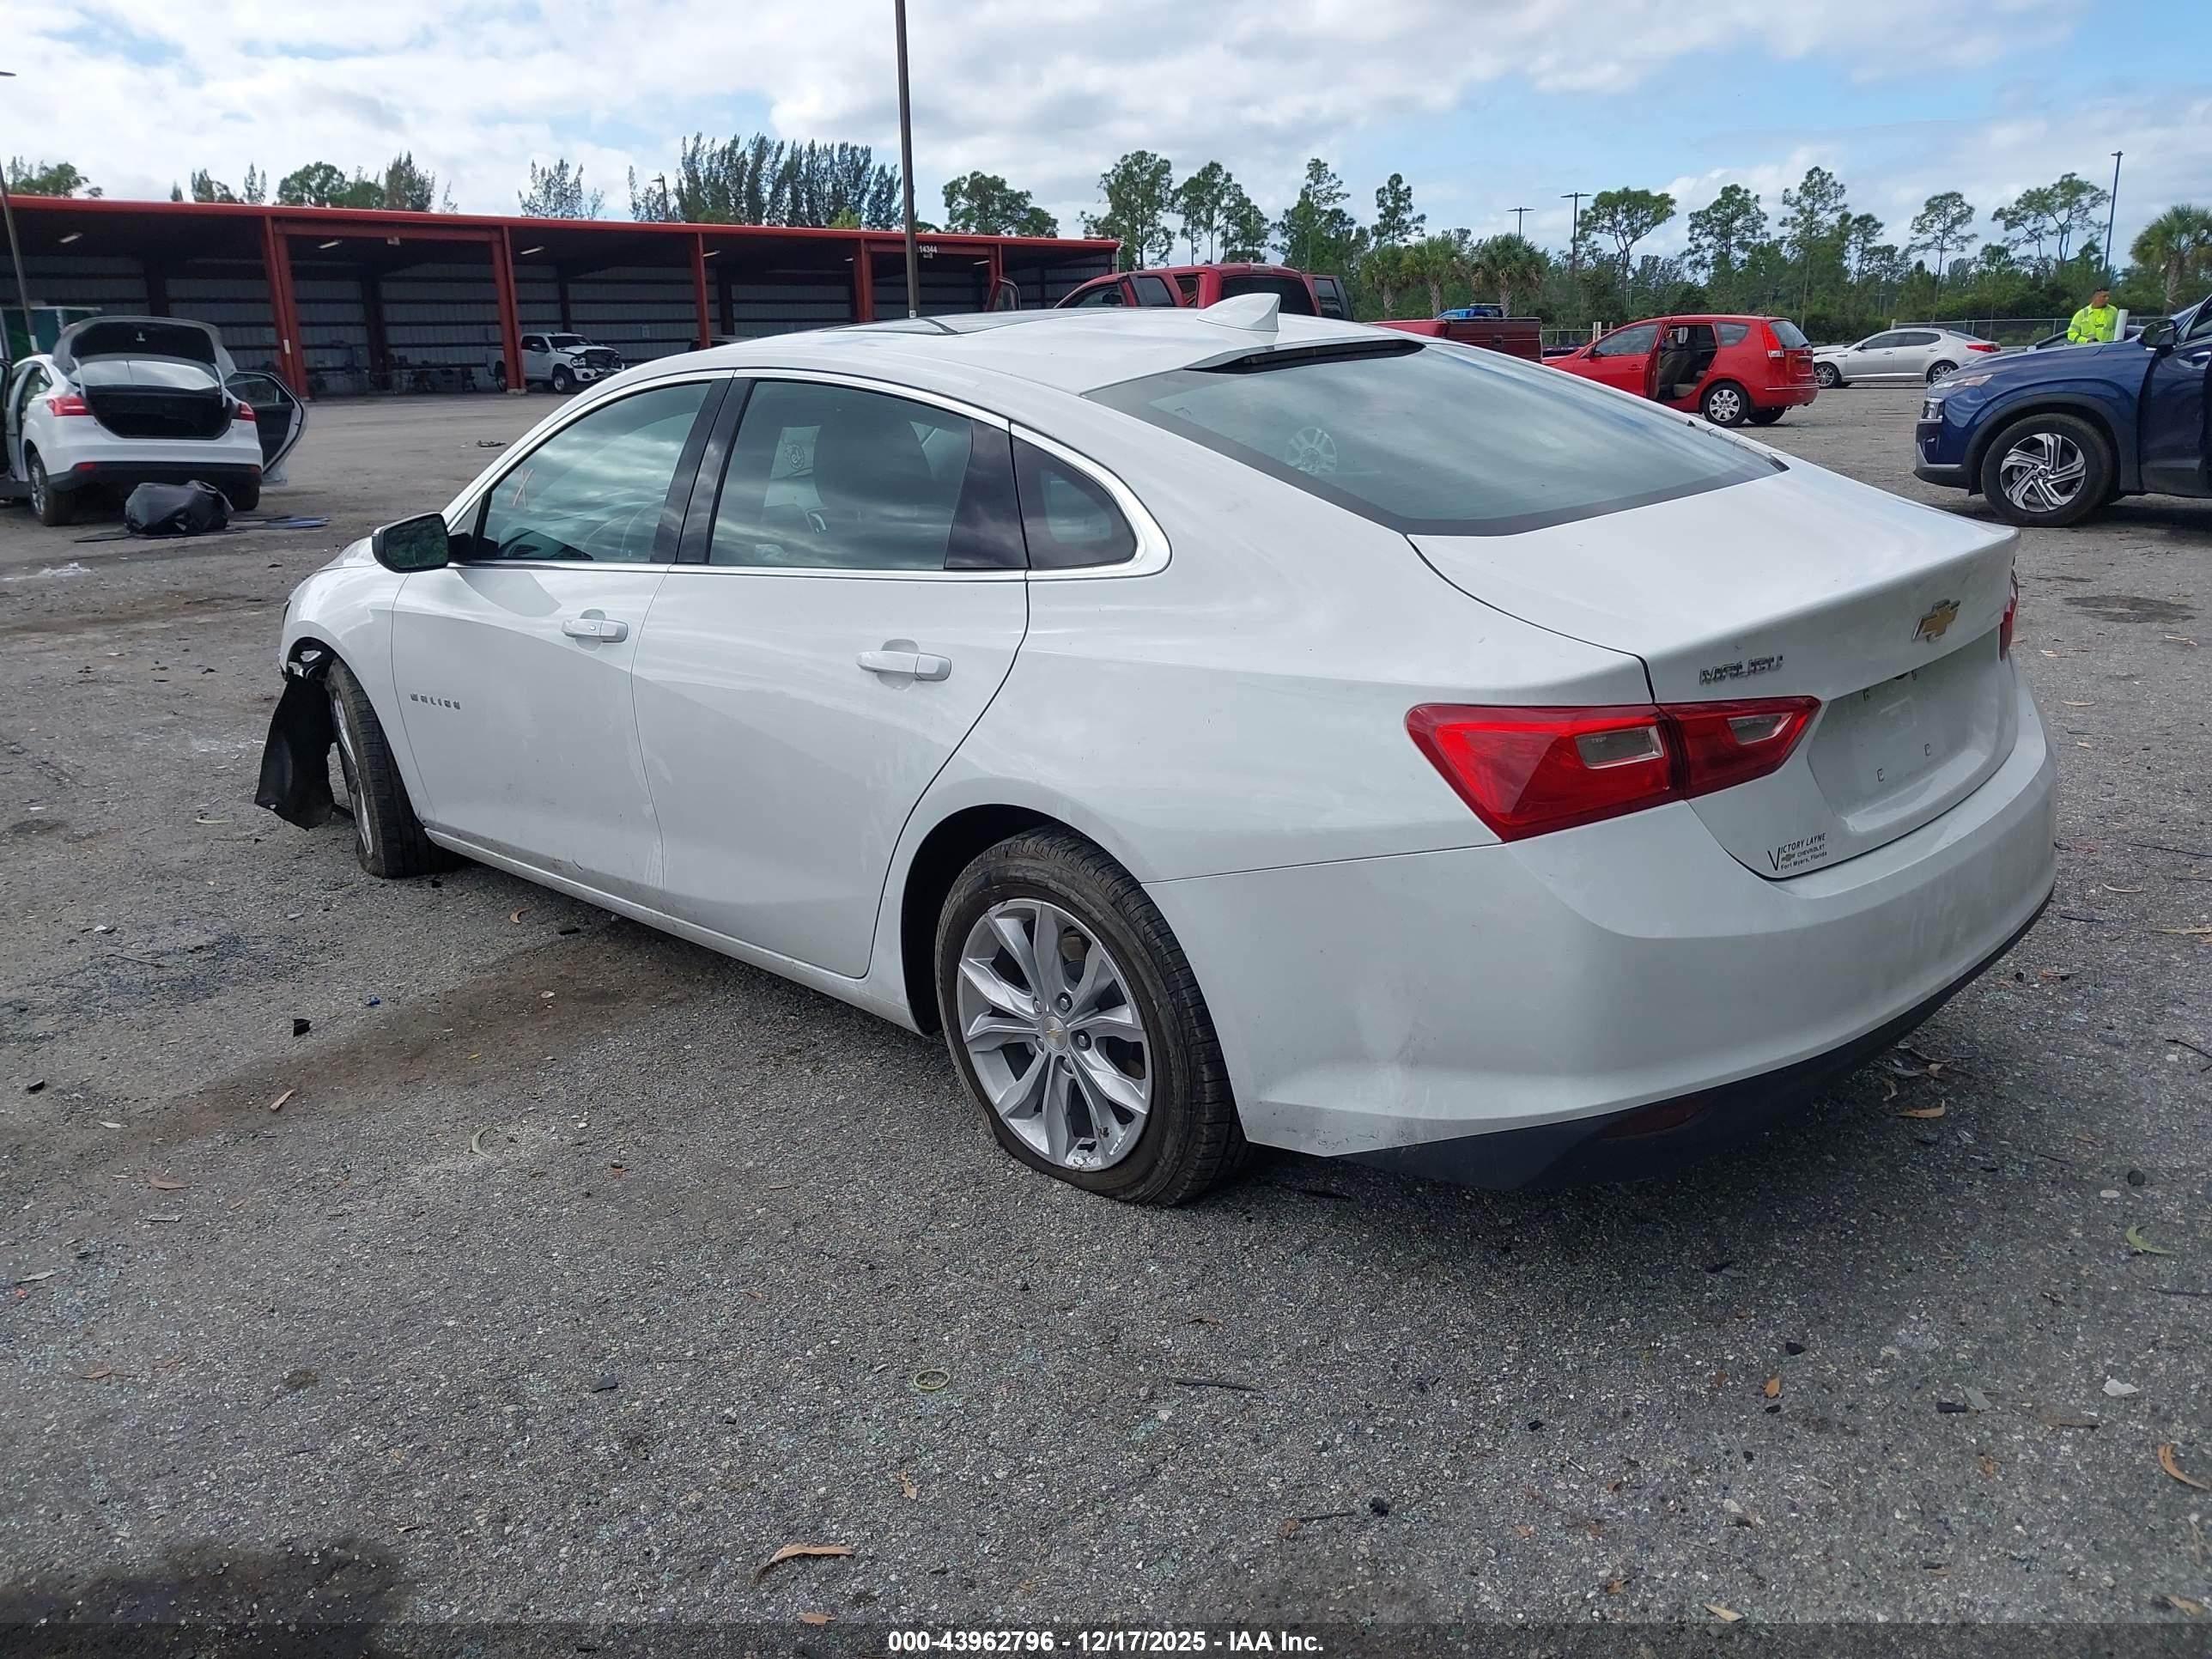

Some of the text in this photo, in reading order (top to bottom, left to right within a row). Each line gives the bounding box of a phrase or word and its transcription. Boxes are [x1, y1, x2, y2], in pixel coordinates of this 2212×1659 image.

[919, 245, 938, 254] 14344
[1699, 654, 1784, 684] MALIBU
[1766, 832, 1826, 871] VICTORY LAYNE
[1797, 843, 1826, 858] CHEVROLET
[1780, 862, 1793, 871] Fort
[1810, 851, 1827, 860] Florida
